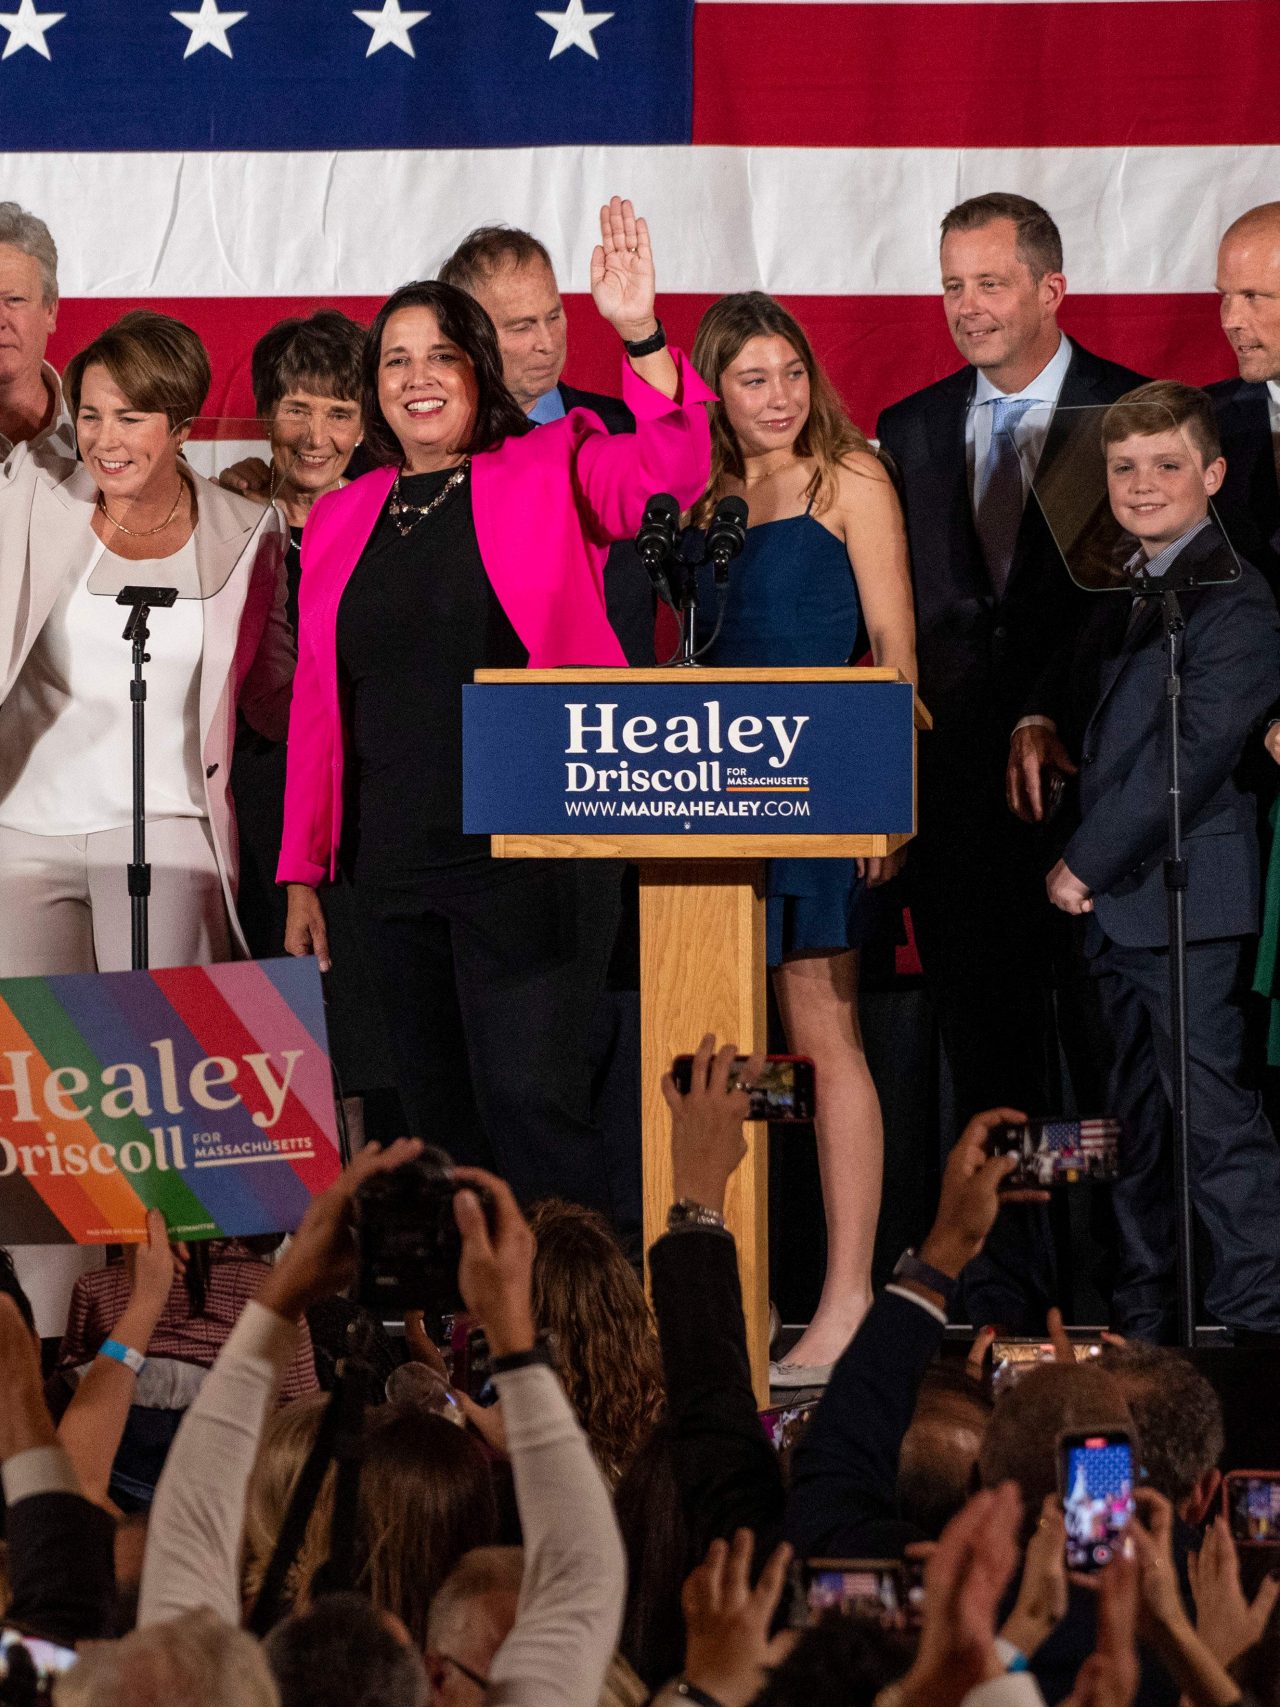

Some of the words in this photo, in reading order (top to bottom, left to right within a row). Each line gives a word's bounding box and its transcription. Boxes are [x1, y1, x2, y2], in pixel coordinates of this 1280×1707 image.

[564, 700, 810, 768] Healey
[564, 760, 722, 793] Driscoll
[726, 767, 747, 776] FOR
[726, 776, 809, 786] MASSACHUSETTS
[564, 800, 811, 817] WWW.MAURAHEALEY.COM
[192, 1131, 221, 1144] FOR
[194, 1136, 313, 1158] MASSACHUSETTS
